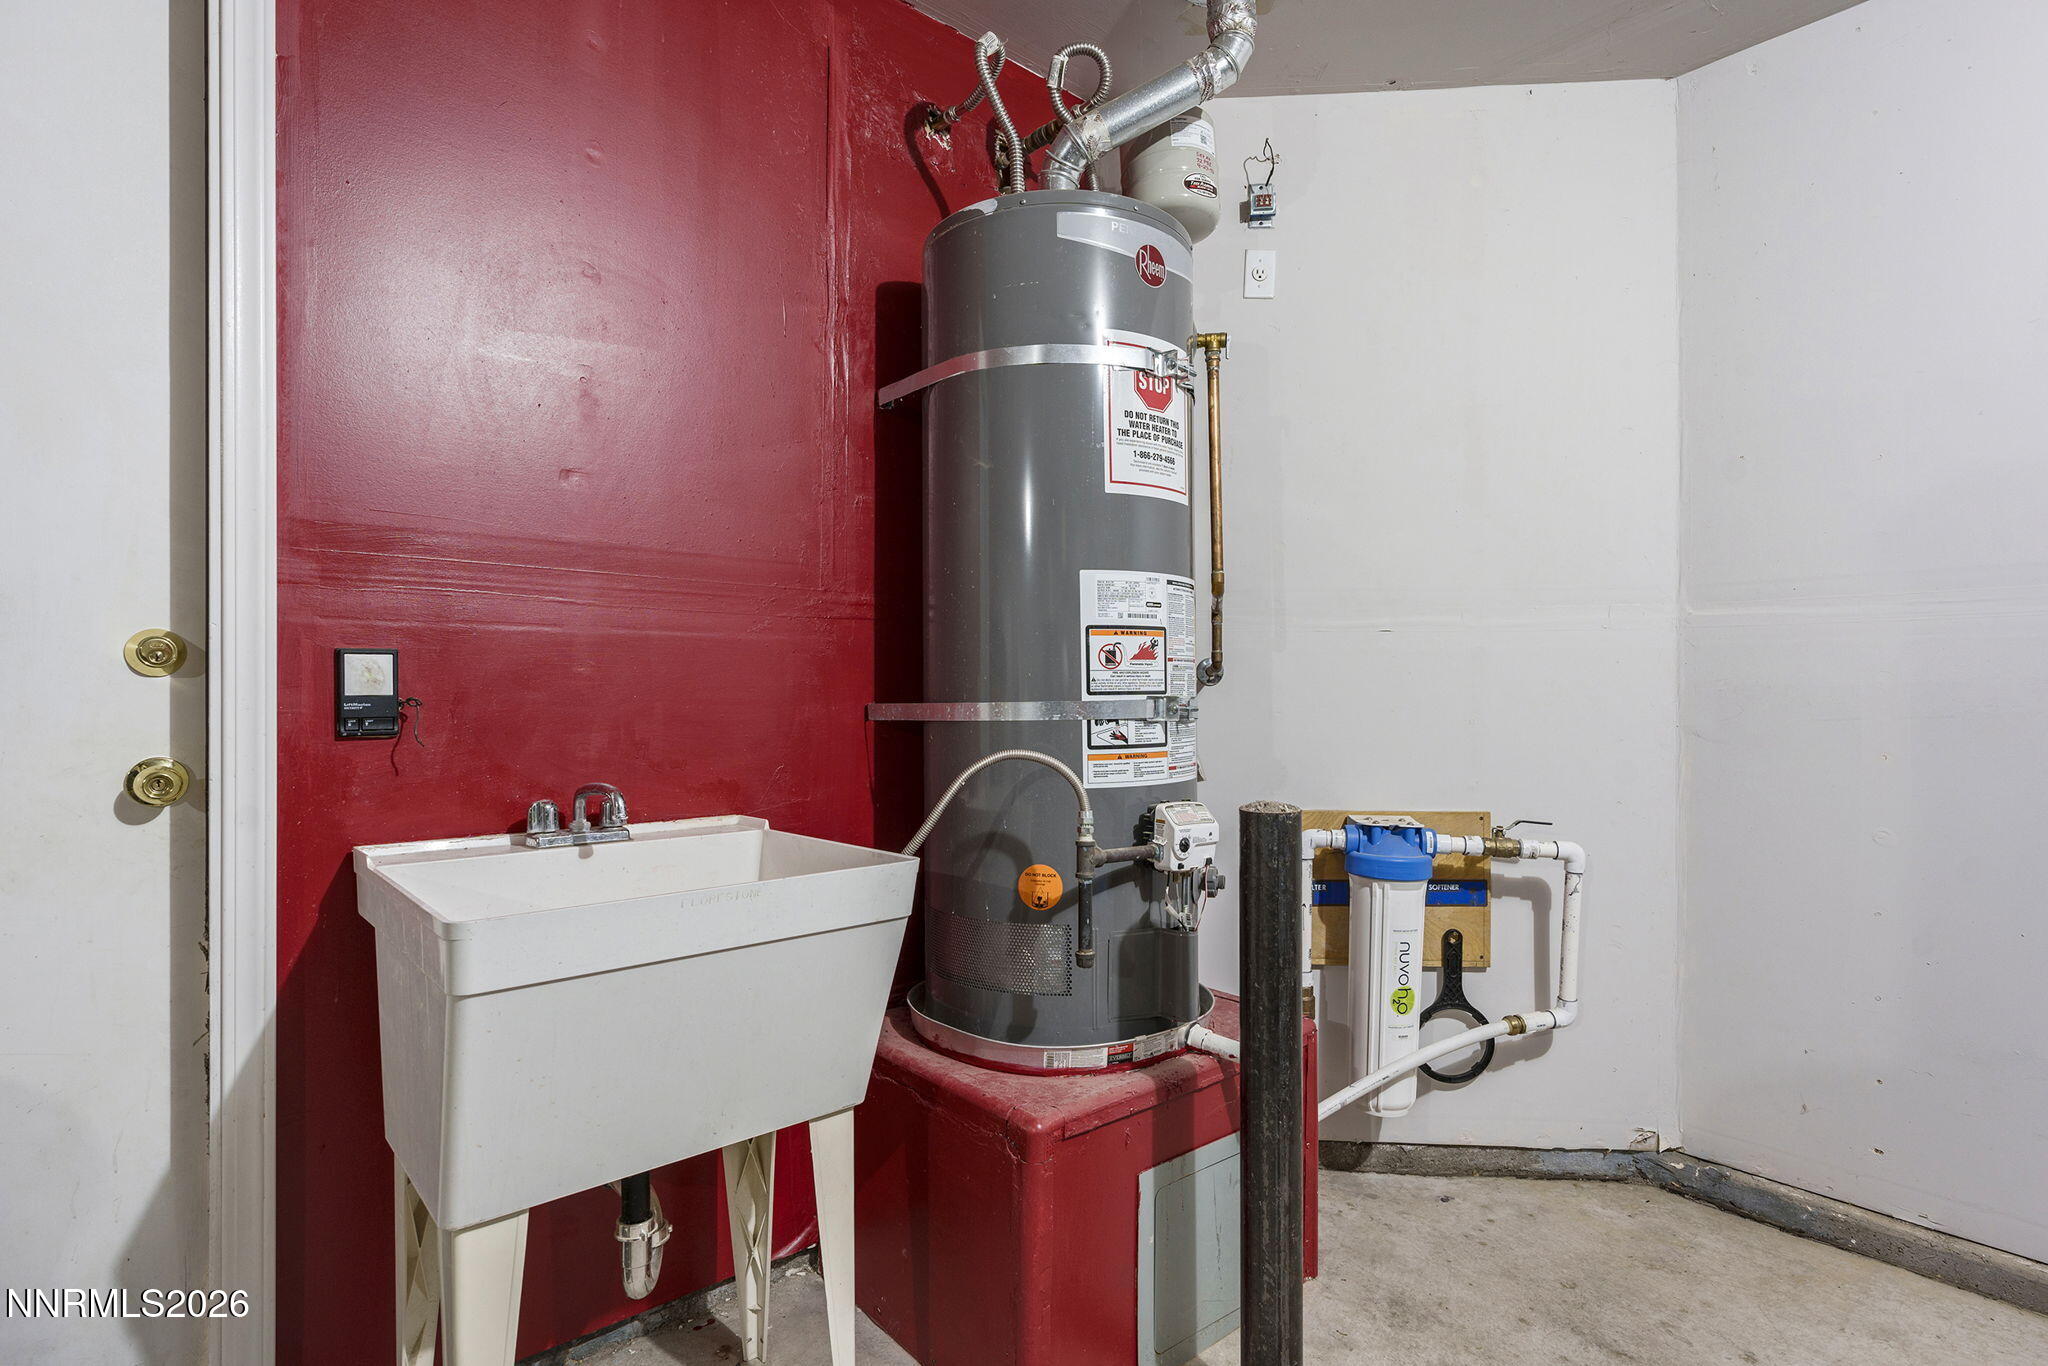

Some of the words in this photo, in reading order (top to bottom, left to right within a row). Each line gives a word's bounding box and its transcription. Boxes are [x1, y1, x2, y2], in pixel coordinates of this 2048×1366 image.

[1139, 245, 1165, 280] Rheem
[1138, 372, 1170, 394] STOP
[1124, 410, 1133, 419] DO
[1135, 411, 1147, 421] NOT
[1149, 414, 1169, 426] RETURN
[1170, 420, 1179, 430] THIS
[1129, 420, 1150, 431] WATER
[1151, 424, 1171, 436] HEATER
[1171, 429, 1177, 438] TO
[1117, 428, 1130, 438] THE
[1132, 430, 1152, 441] PLACE
[1153, 433, 1160, 442] OF
[1161, 435, 1183, 450] PURCHASE
[1428, 883, 1460, 891] SOFTENER
